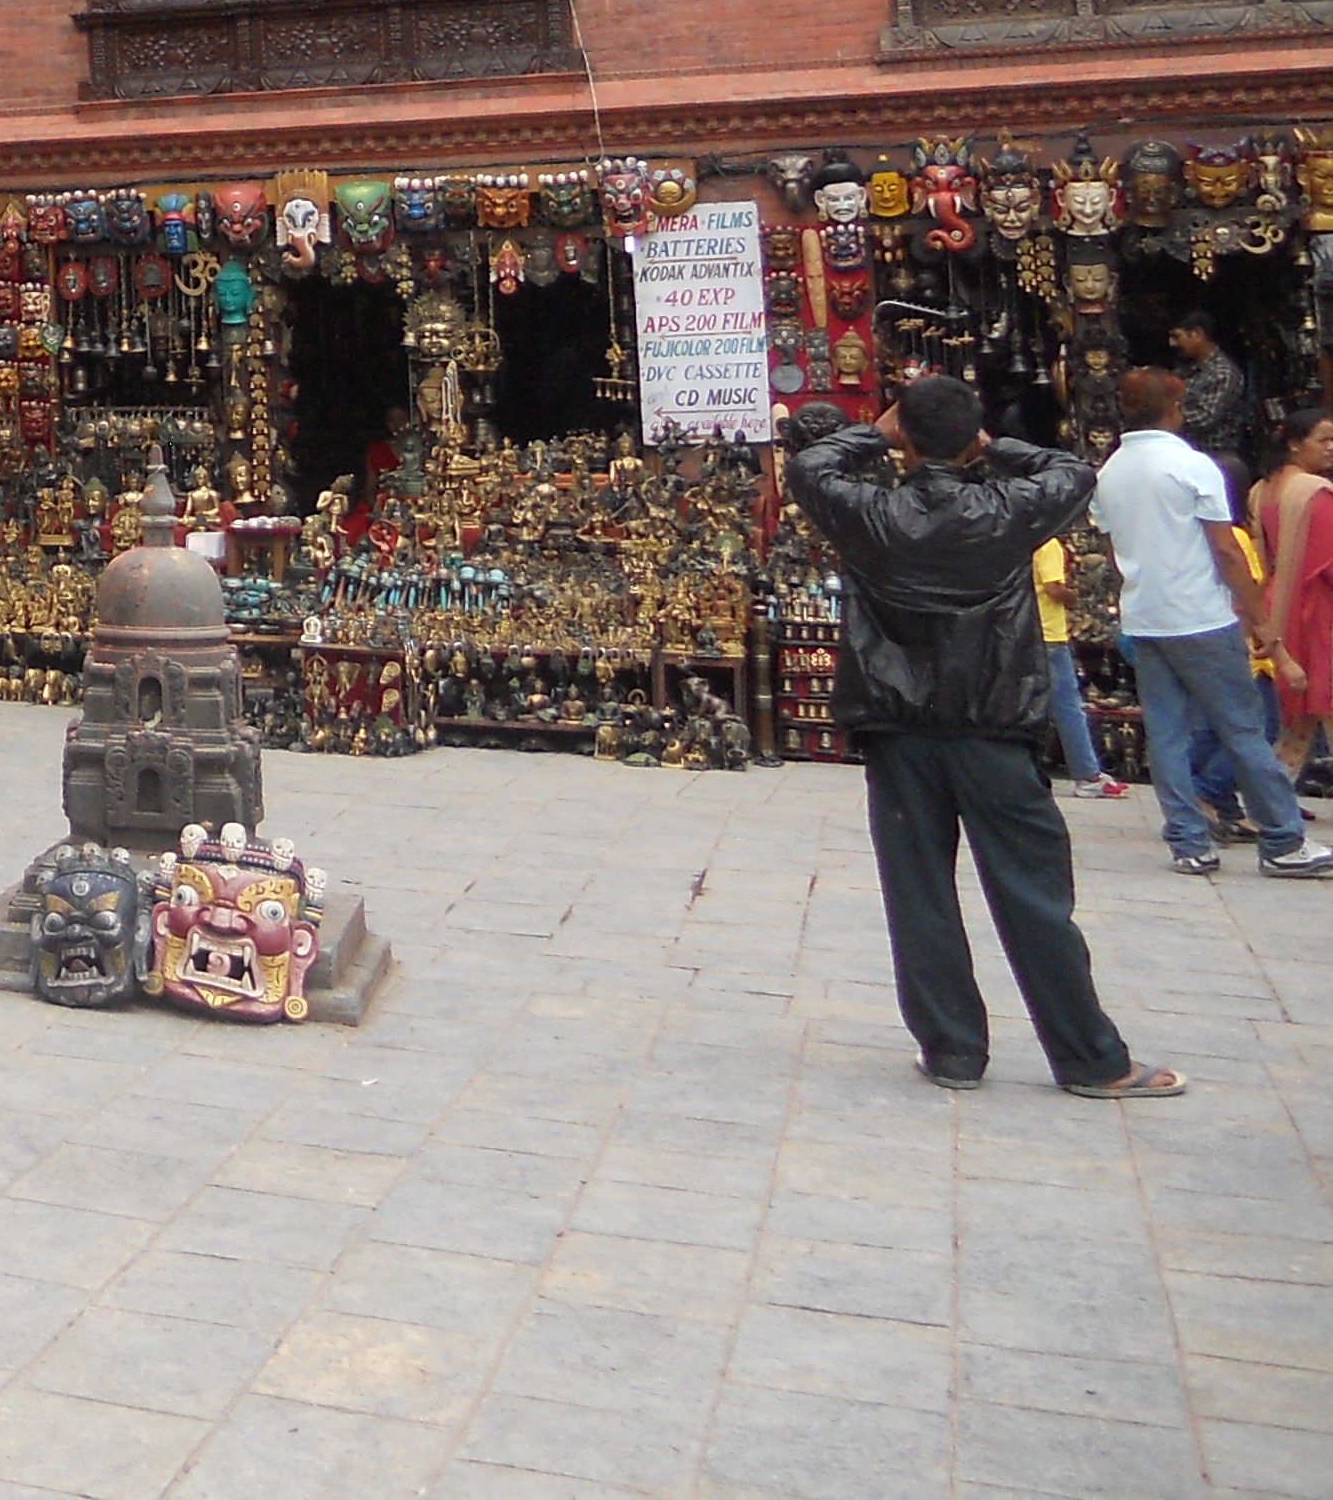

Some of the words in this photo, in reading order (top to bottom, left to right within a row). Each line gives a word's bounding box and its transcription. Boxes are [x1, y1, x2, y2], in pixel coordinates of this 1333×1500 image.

[655, 214, 699, 233] MERA
[707, 211, 754, 230] FILMS
[645, 237, 746, 259] BATTERIES
[639, 264, 686, 283] KODAK
[690, 261, 755, 280] ADVANTIX
[664, 289, 694, 307] 40
[697, 287, 736, 306] EXP
[643, 315, 681, 334] APS
[685, 313, 718, 332] 200
[721, 311, 765, 330] FILM
[643, 339, 712, 359] FUJICOLOR
[714, 337, 738, 356] 200
[739, 335, 766, 354] FILM
[646, 365, 678, 382] DVC
[684, 361, 763, 381] CASSETTE
[674, 389, 700, 407] CD
[706, 387, 759, 406] MUSIC
